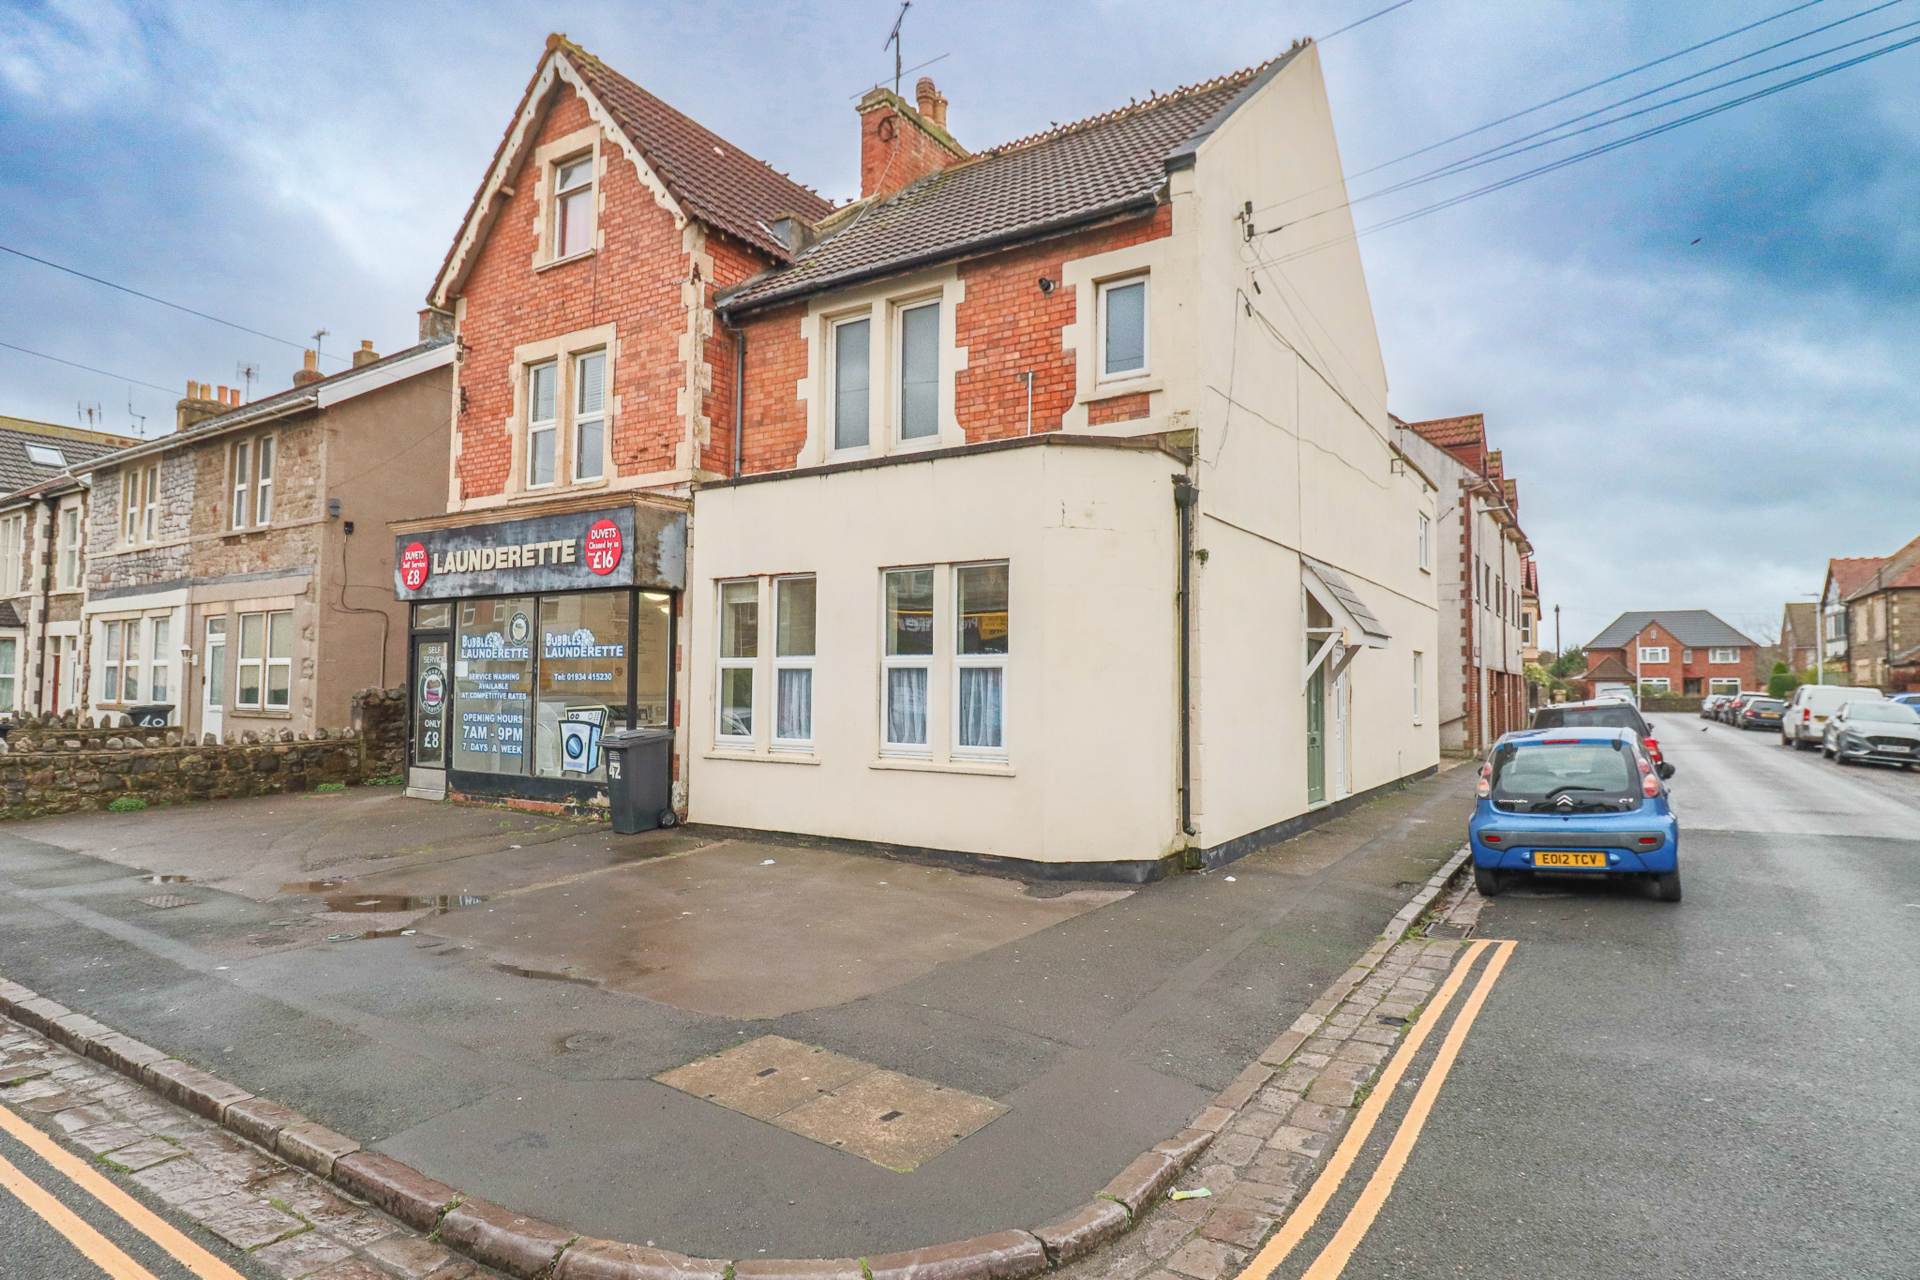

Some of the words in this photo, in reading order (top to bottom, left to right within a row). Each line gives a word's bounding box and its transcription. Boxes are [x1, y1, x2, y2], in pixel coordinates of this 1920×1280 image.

[591, 527, 616, 540] DUVETS
[405, 549, 424, 561] DUVETS
[433, 538, 577, 575] LAUNDERETTE
[592, 550, 614, 569] £16
[407, 569, 420, 585] £8
[461, 647, 529, 659] LAUNDERETTE
[545, 644, 625, 658] LAUNDERETTE
[468, 673, 492, 681] SERVICE
[493, 672, 520, 681] WASHING
[566, 673, 587, 681] 01934
[587, 673, 612, 681] 415230
[469, 692, 507, 700] COMPETITIVE
[507, 692, 527, 700] RATES
[139, 714, 165, 727] 40
[424, 719, 441, 728] ONLY
[463, 713, 495, 722] OPENING
[497, 714, 523, 724] HOURS
[423, 730, 439, 748] £8
[463, 726, 488, 739] 7AM
[498, 727, 523, 741] 9PM
[470, 743, 488, 752] DAYS
[491, 743, 498, 752] A
[501, 744, 523, 754] WEEK
[609, 762, 622, 780] 42
[1572, 853, 1597, 865] TCV
